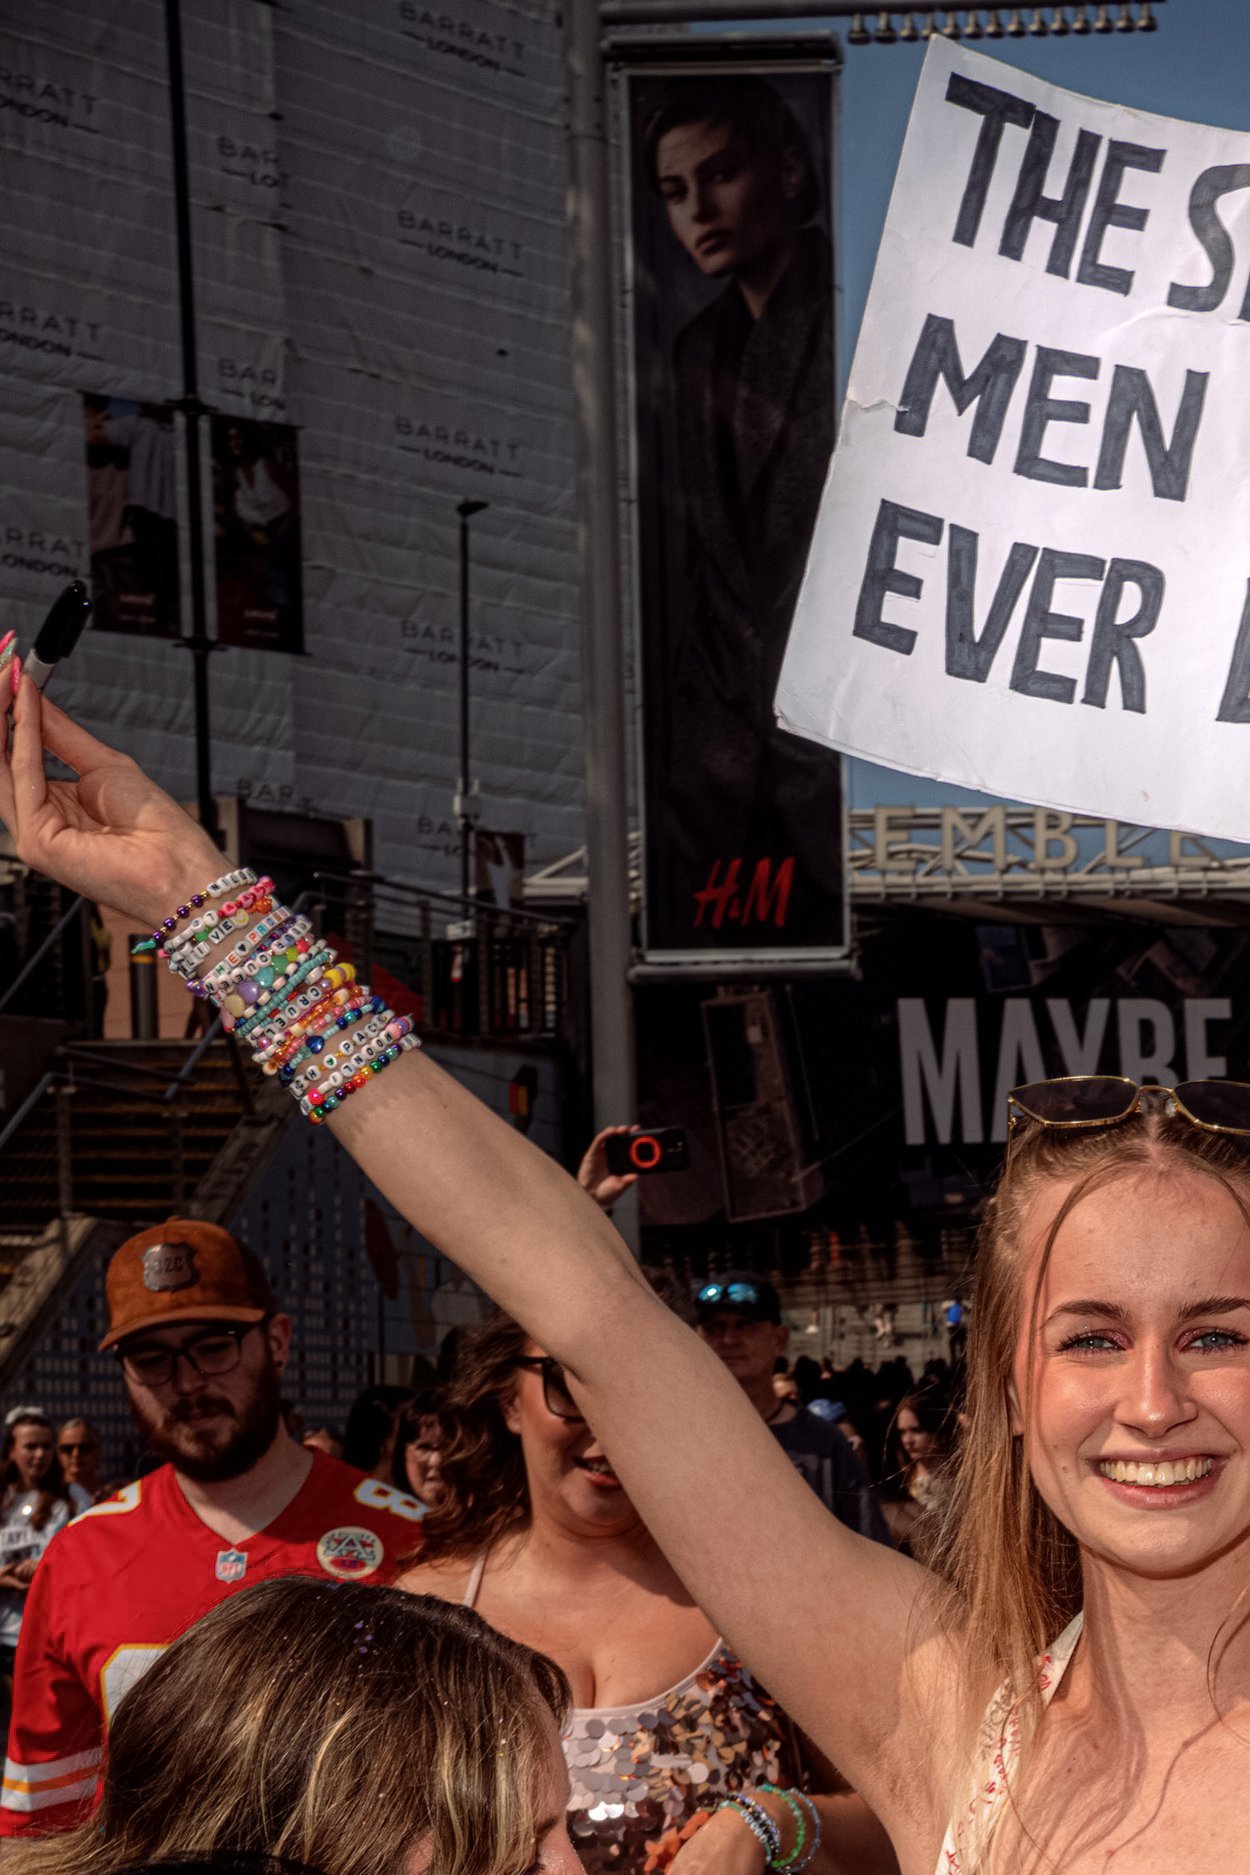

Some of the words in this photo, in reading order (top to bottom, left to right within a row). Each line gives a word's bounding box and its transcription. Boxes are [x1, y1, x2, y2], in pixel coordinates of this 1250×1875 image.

[945, 71, 1167, 297] THE
[893, 314, 1210, 502] MEN
[851, 498, 1166, 715] EVER
[692, 856, 796, 930] H&M
